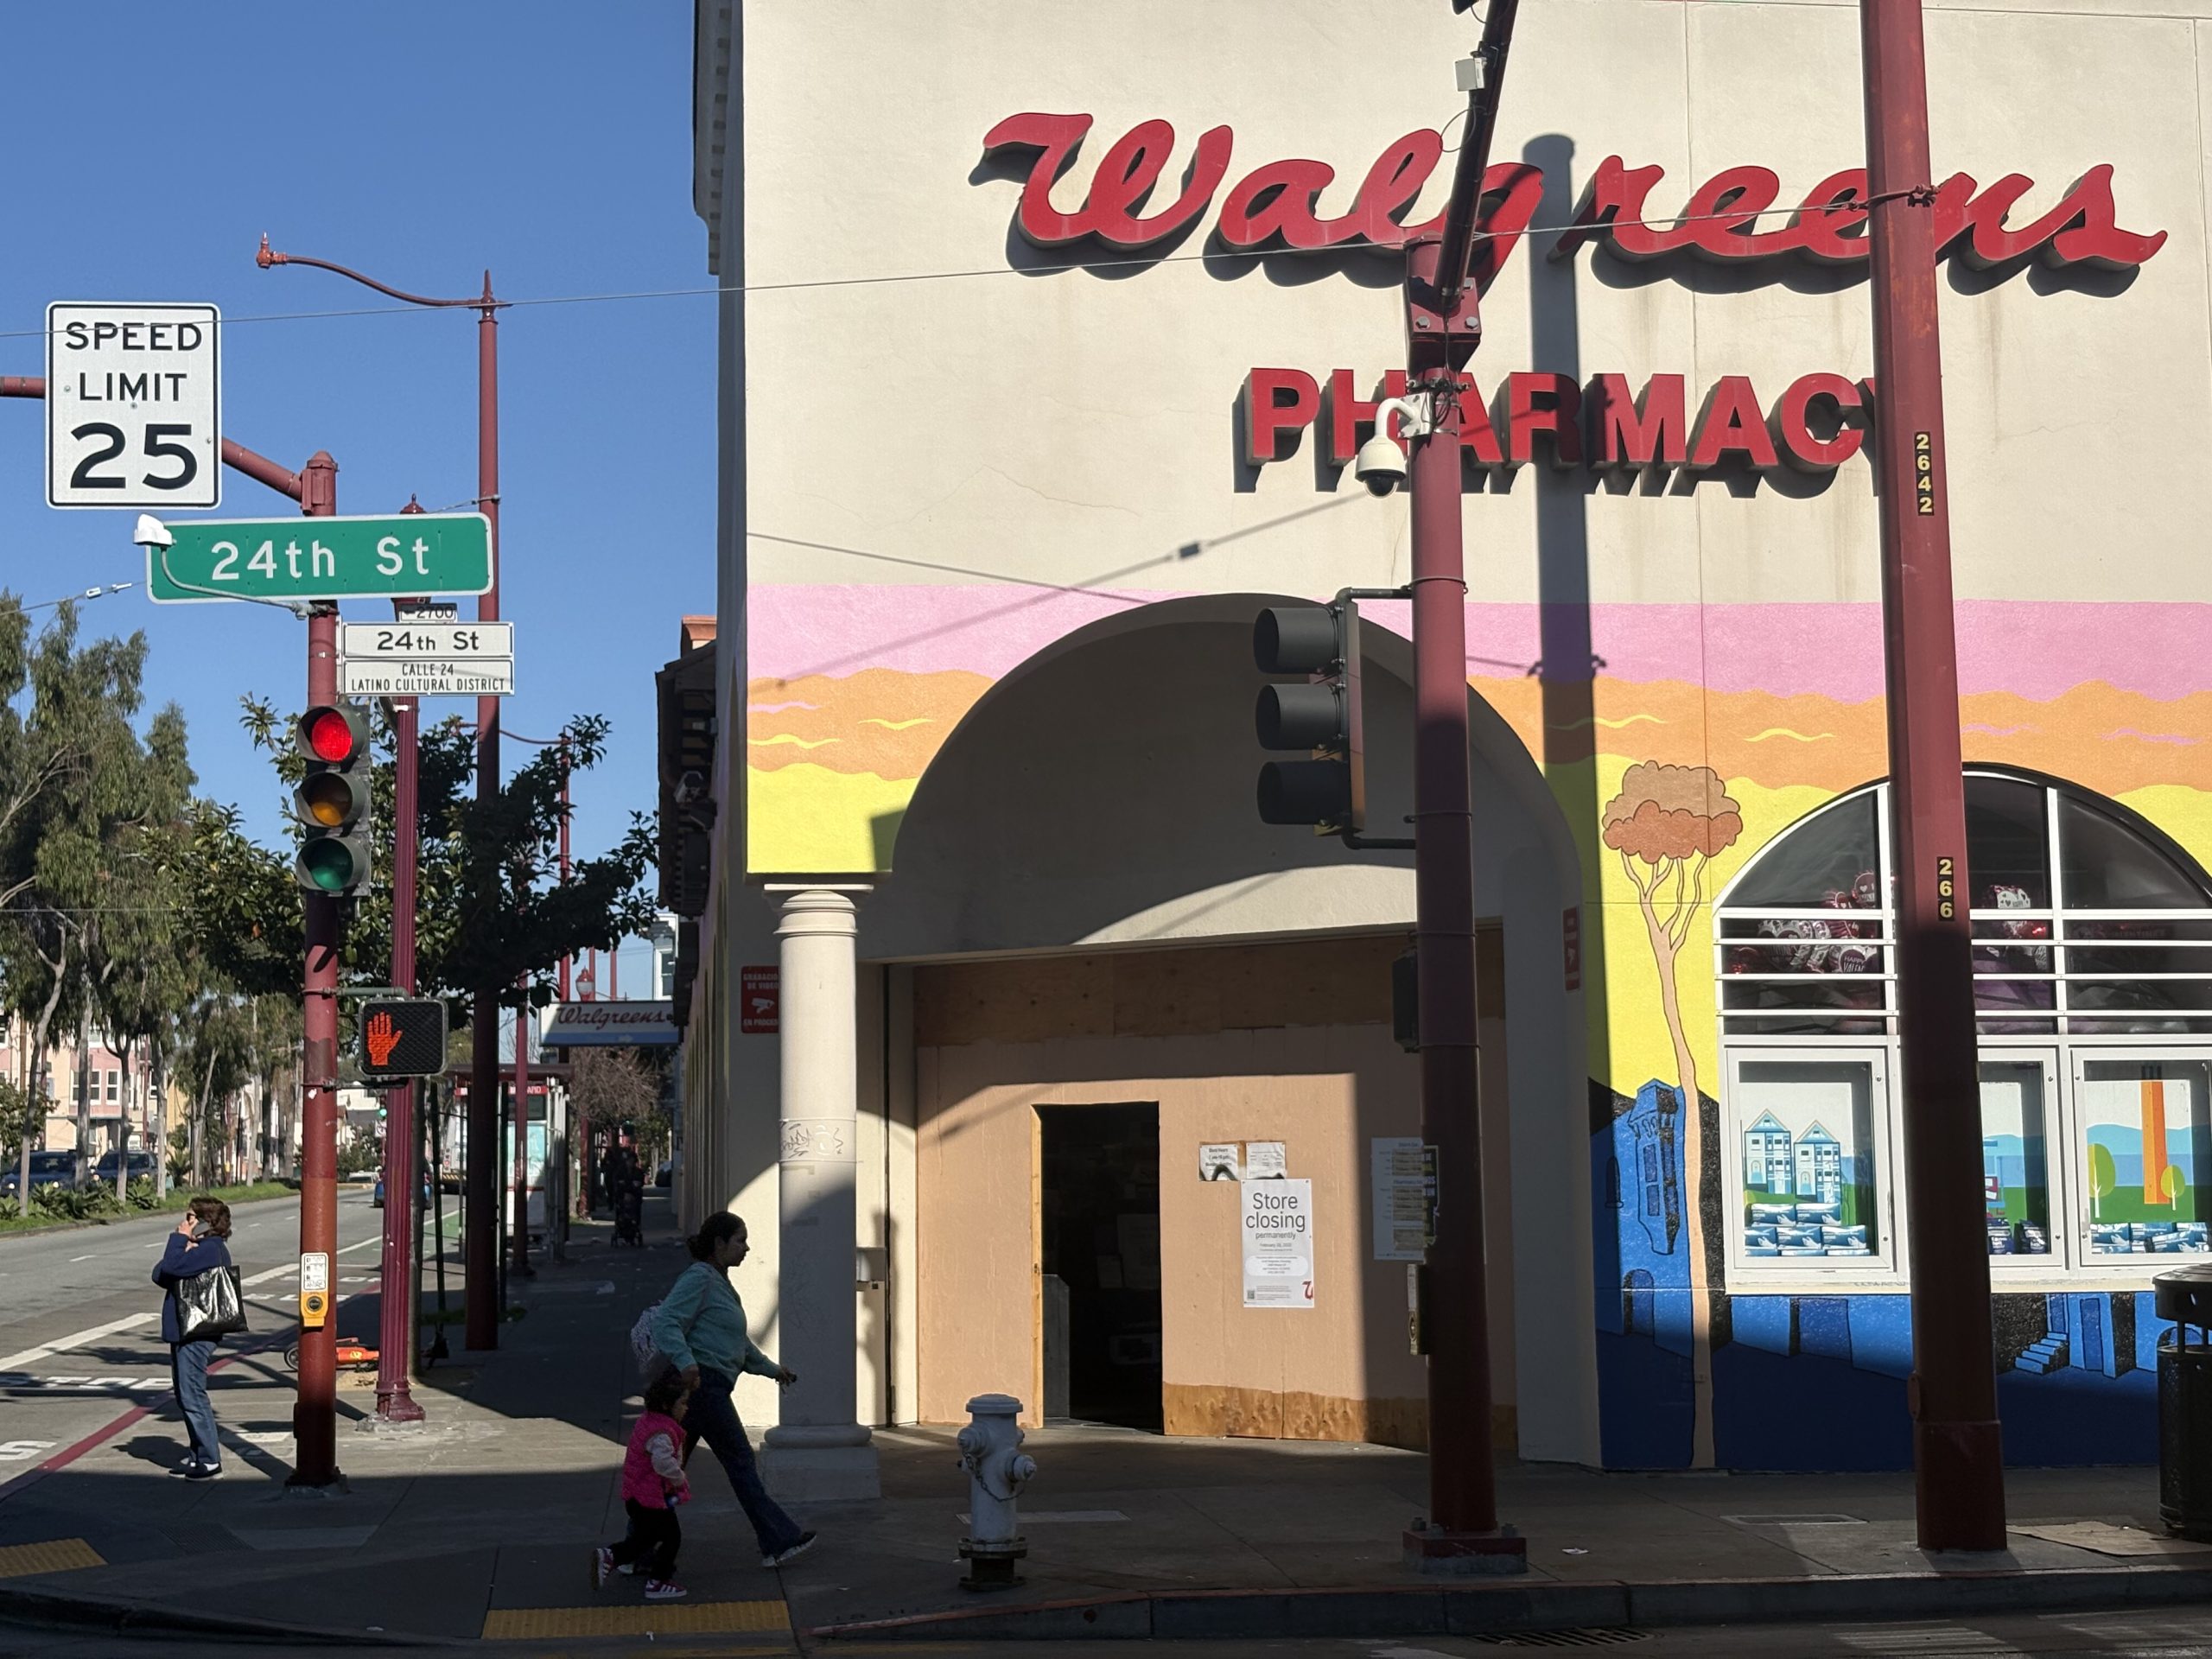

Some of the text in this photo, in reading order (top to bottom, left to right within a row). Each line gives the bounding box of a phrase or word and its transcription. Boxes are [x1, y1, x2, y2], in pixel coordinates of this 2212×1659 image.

[982, 112, 2168, 282] Walgreens
[65, 321, 201, 351] SPEED
[79, 372, 187, 401] LIMIT
[1250, 367, 1874, 465] PHARMAC
[70, 422, 198, 490] 25
[1916, 433, 1933, 513] 2642
[211, 536, 429, 580] 24th St
[416, 607, 454, 619] 2700
[377, 631, 480, 651] 24th St
[352, 678, 505, 691] LATINO CULTURAL DISTRICT
[402, 663, 454, 677] CALLE 24
[1939, 858, 1953, 918] 266
[556, 1005, 665, 1030] Walgreens
[1253, 1192, 1298, 1210] Store
[1246, 1211, 1306, 1232] closing
